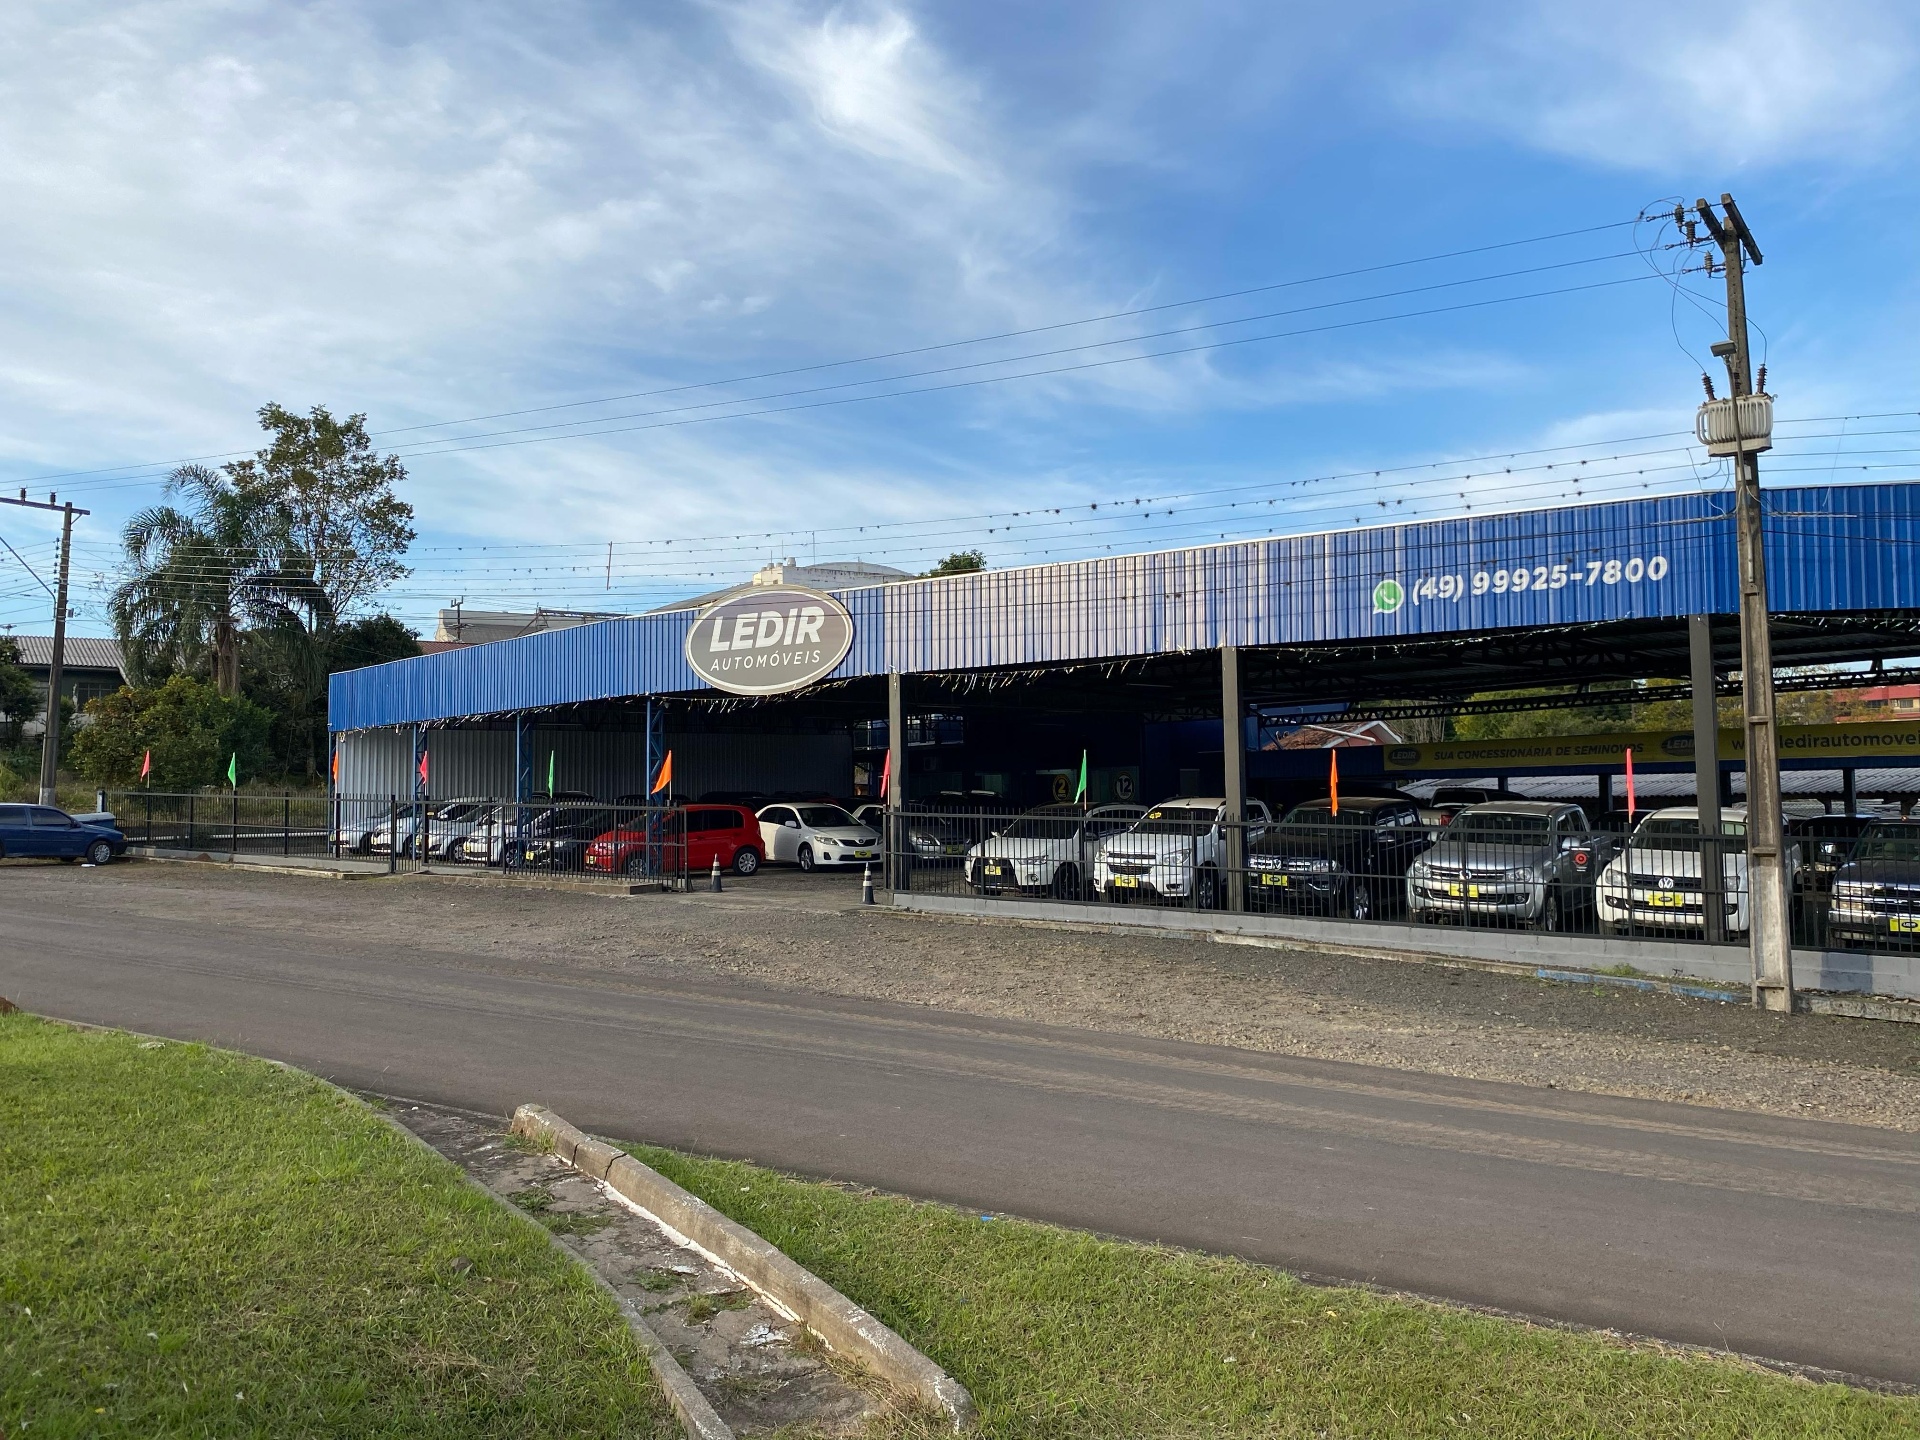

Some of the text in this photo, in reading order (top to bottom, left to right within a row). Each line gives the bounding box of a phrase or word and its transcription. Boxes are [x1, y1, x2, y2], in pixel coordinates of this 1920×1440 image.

[1412, 556, 1668, 606] (49) 99925-7800
[709, 606, 825, 652] LEDIR
[710, 650, 821, 672] AUTOMÓVEIS
[1434, 743, 1644, 761] SUA CONCESSIONÁRIA DE SEMINOVOS
[1666, 739, 1695, 749] LEDI
[1391, 751, 1416, 760] LEDIR
[1118, 778, 1131, 793] 12
